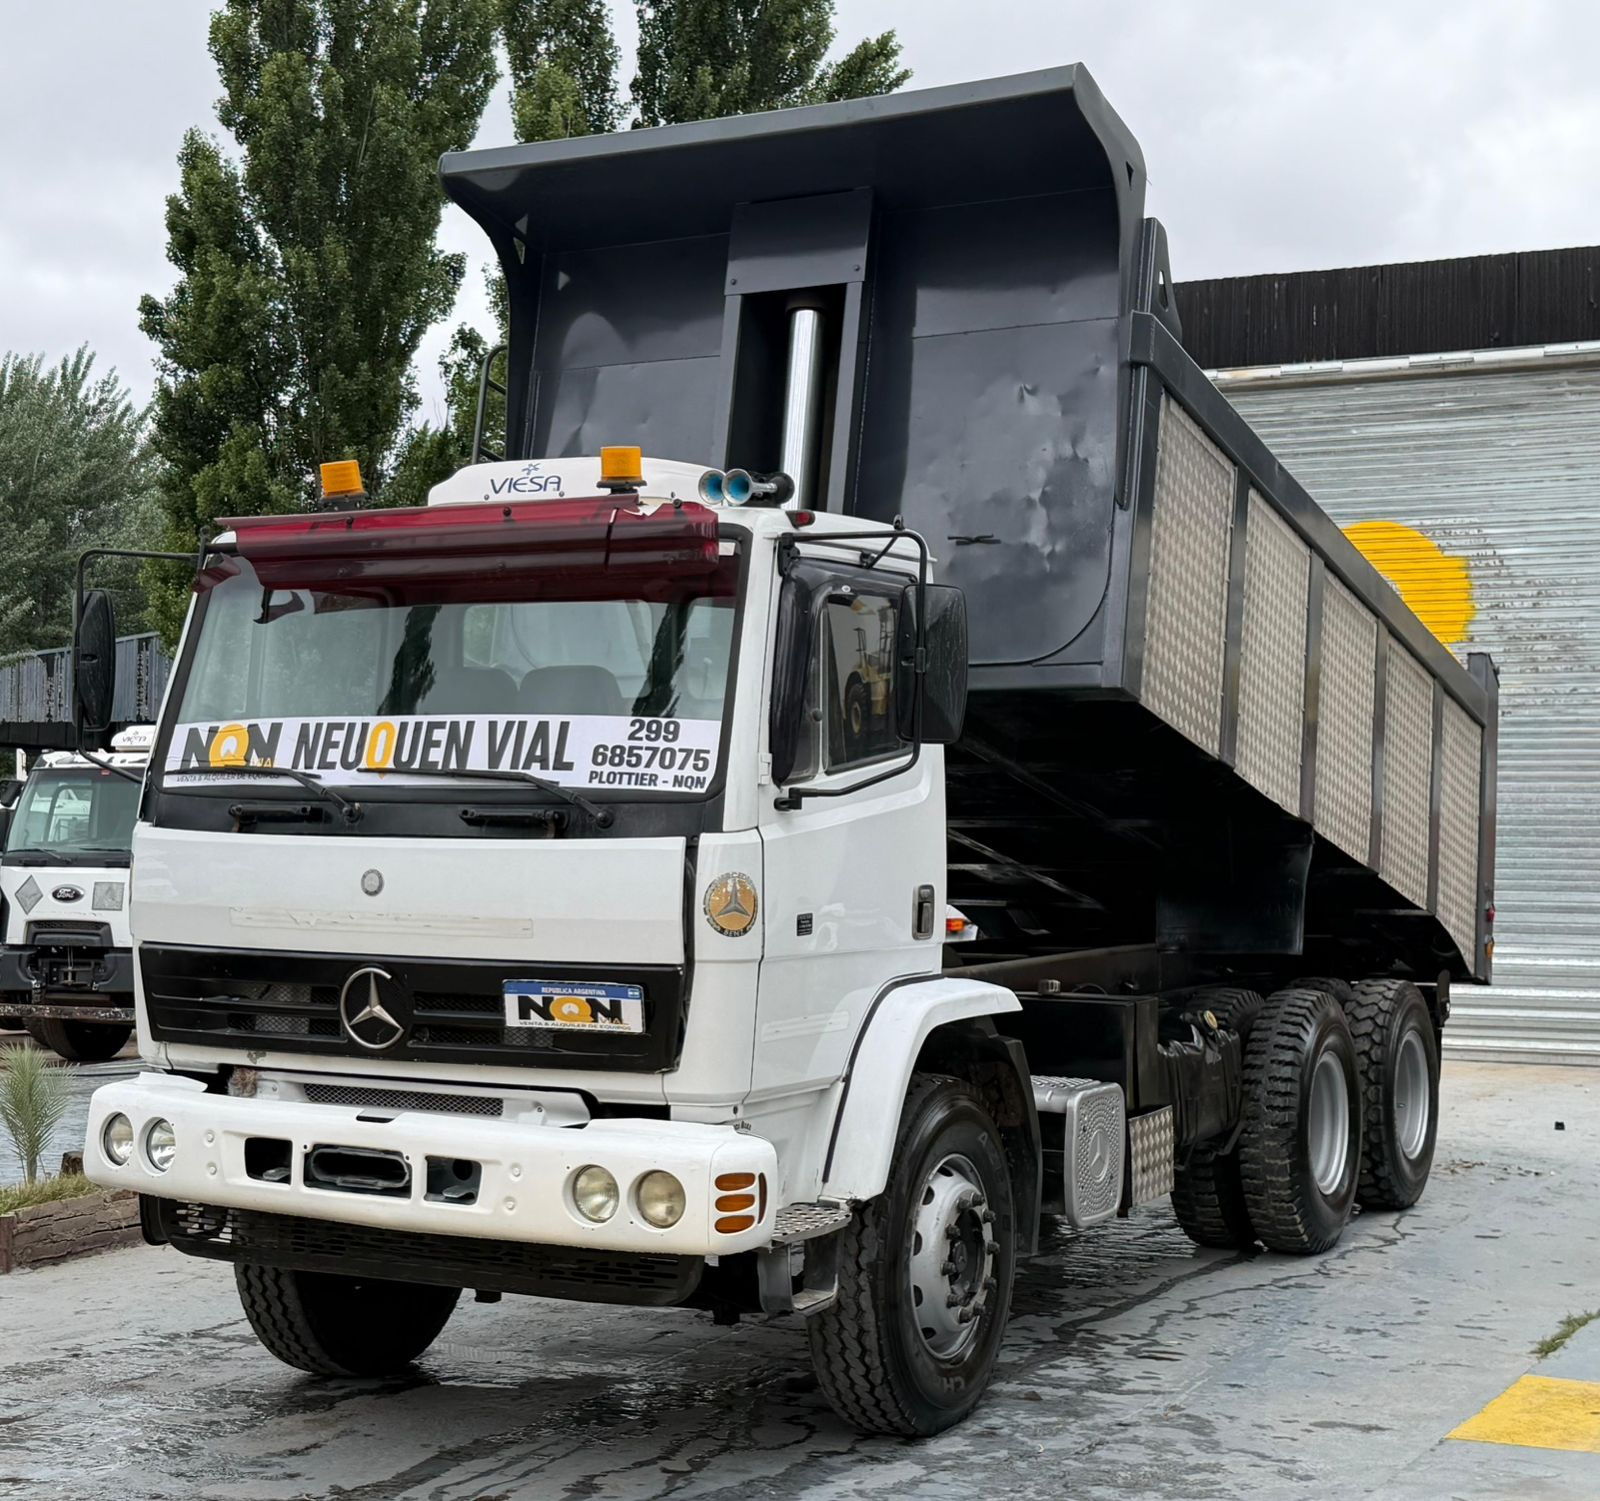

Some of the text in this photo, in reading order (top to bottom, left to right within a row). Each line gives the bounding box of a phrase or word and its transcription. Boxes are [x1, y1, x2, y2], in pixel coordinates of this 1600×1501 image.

[490, 474, 562, 495] VIESA
[627, 718, 680, 743] 299
[180, 721, 284, 769] NQN
[292, 719, 575, 775] NEUQUEN VIAL
[591, 744, 711, 772] 6857075
[588, 770, 658, 787] PLOTTIER
[672, 775, 707, 789] NQN
[573, 988, 607, 997] ARGENTINA
[517, 995, 624, 1025] NQN
[550, 1021, 587, 1029] ALQUILER
